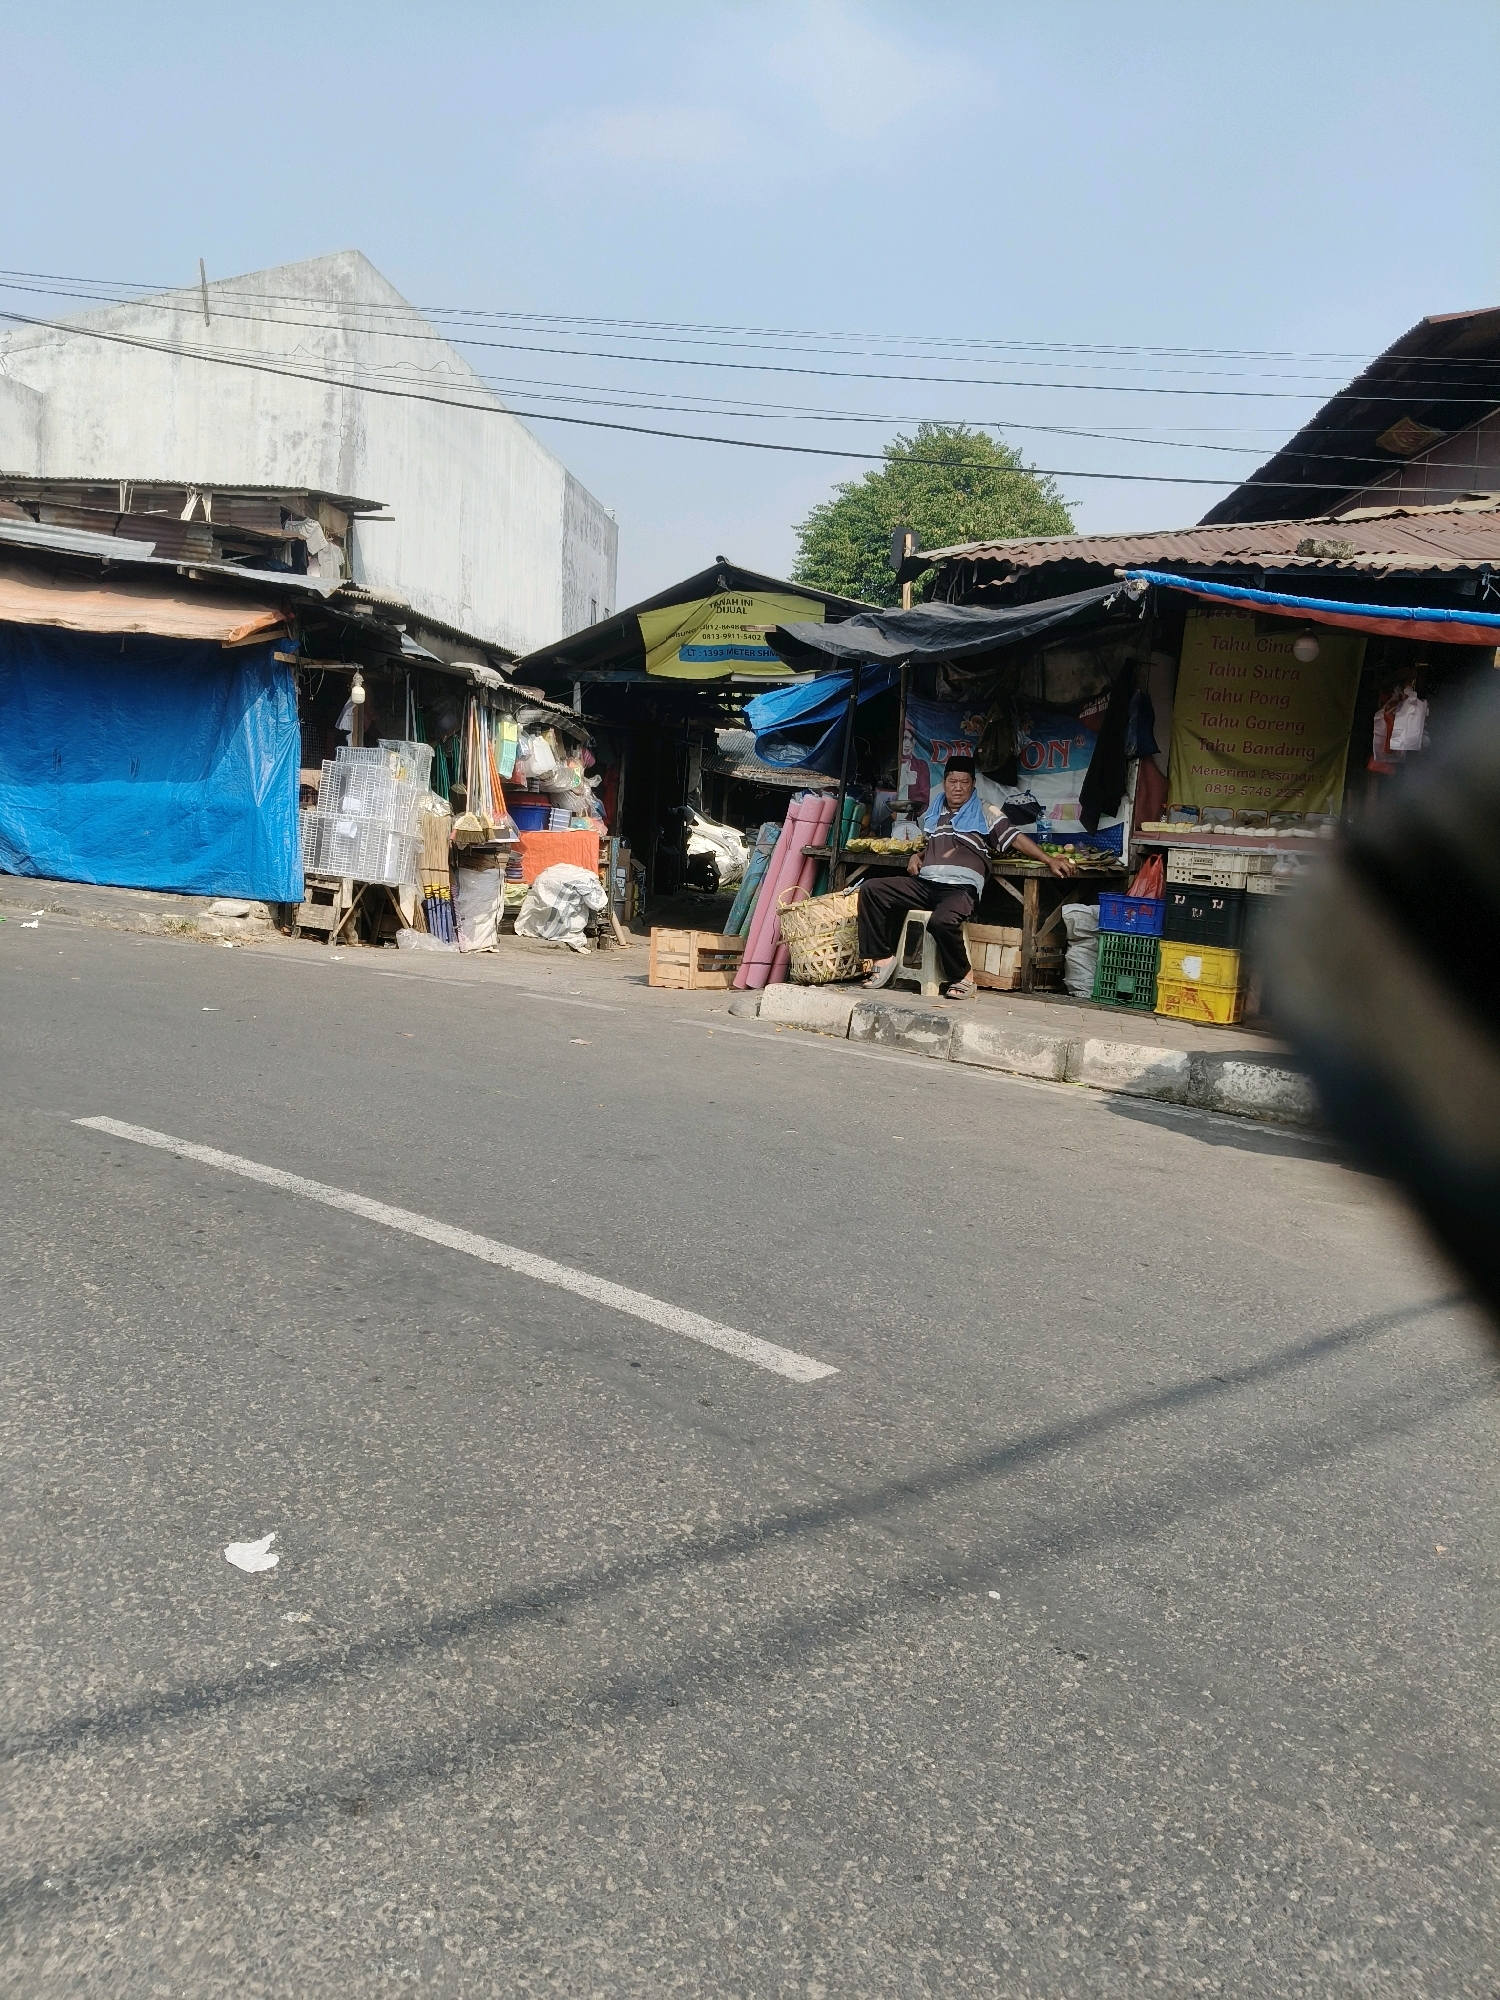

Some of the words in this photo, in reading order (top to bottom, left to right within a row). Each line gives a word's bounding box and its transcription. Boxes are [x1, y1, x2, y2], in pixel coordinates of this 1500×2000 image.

[709, 598, 739, 609] TANAH
[741, 598, 754, 607] INI
[716, 606, 748, 615] DIJUAL
[702, 633, 762, 641] 0813-9911-5402
[1211, 635, 1250, 651] Tahu
[687, 649, 697, 657] LT
[703, 649, 725, 657] 1393
[726, 648, 756, 657] METER
[1207, 661, 1247, 678] Tahu
[1253, 664, 1301, 681] Sutra
[1204, 687, 1243, 703] Tahu
[1249, 690, 1291, 709] Pong
[1200, 712, 1239, 728] Tahu
[1245, 715, 1306, 736] Goreng
[929, 738, 1073, 770] DRON
[1198, 737, 1236, 753] Tahu
[1243, 740, 1316, 761] Bandung
[1191, 764, 1256, 779] Menerima
[1260, 768, 1315, 783] Pesanan
[1204, 783, 1236, 795] 0819
[1240, 785, 1271, 797] 5748
[1276, 788, 1305, 799] 2275
